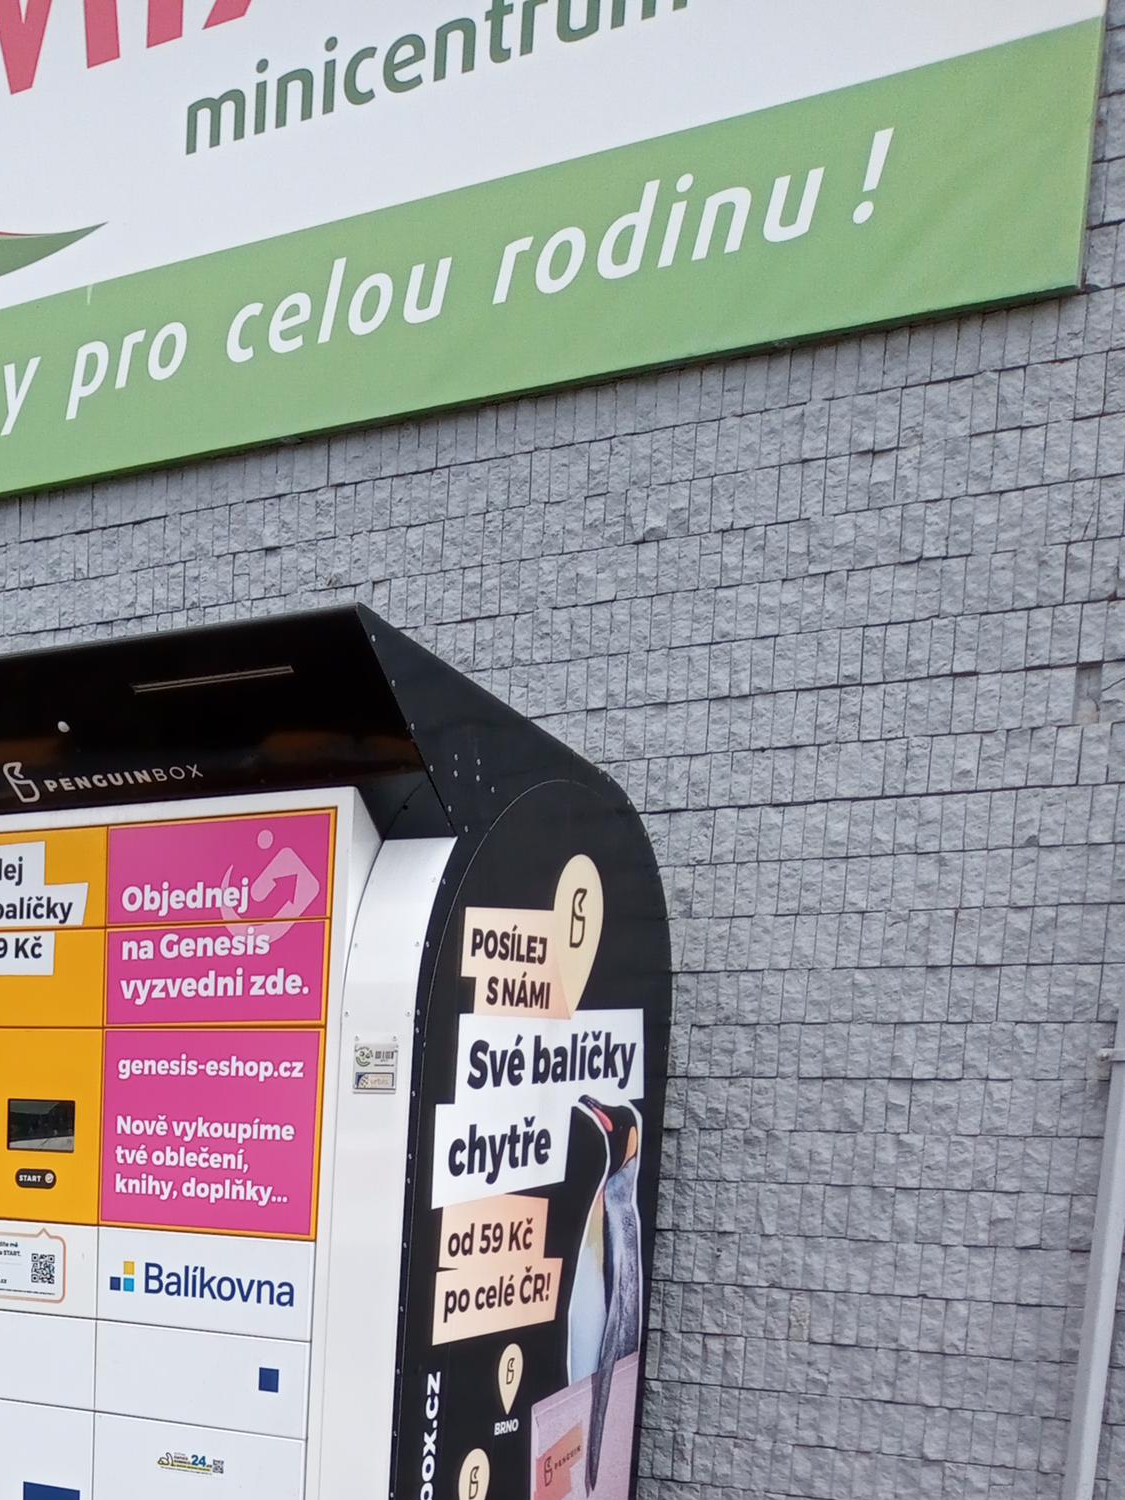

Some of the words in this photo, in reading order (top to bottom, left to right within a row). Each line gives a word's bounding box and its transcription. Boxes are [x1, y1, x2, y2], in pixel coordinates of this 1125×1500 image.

[65, 321, 188, 420] pro
[226, 258, 452, 363] celou
[492, 166, 824, 304] rodinu
[43, 764, 204, 792] PENGUINBOX
[122, 877, 249, 917] Objednej
[14, 935, 43, 959] Kč
[122, 940, 154, 960] na
[160, 926, 270, 959] Genesis
[471, 925, 548, 965] POSÍLEJ
[120, 967, 244, 1005] vyzvedni
[249, 968, 310, 996] zde.
[486, 976, 499, 1006] S
[501, 972, 551, 1009] NÁMI
[118, 1054, 304, 1082] genesis-eshop.cz
[467, 1034, 526, 1090] Své
[531, 1030, 637, 1090] balíčky
[116, 1115, 168, 1136] Nově
[172, 1117, 295, 1144] vykoupíme
[116, 1144, 148, 1165] tvé
[151, 1146, 249, 1173] oblečení,
[448, 1116, 552, 1184] chytře
[19, 1174, 42, 1182] START
[115, 1173, 178, 1200] knihy,
[182, 1177, 288, 1206] doplňky...
[448, 1222, 475, 1257] od
[479, 1222, 504, 1254] 59
[508, 1217, 533, 1251] Kč
[144, 1261, 295, 1308] Balíkovna
[443, 1288, 471, 1323] po
[475, 1274, 515, 1310] celé
[519, 1265, 551, 1304] ČR!
[494, 1418, 519, 1436] BRNO
